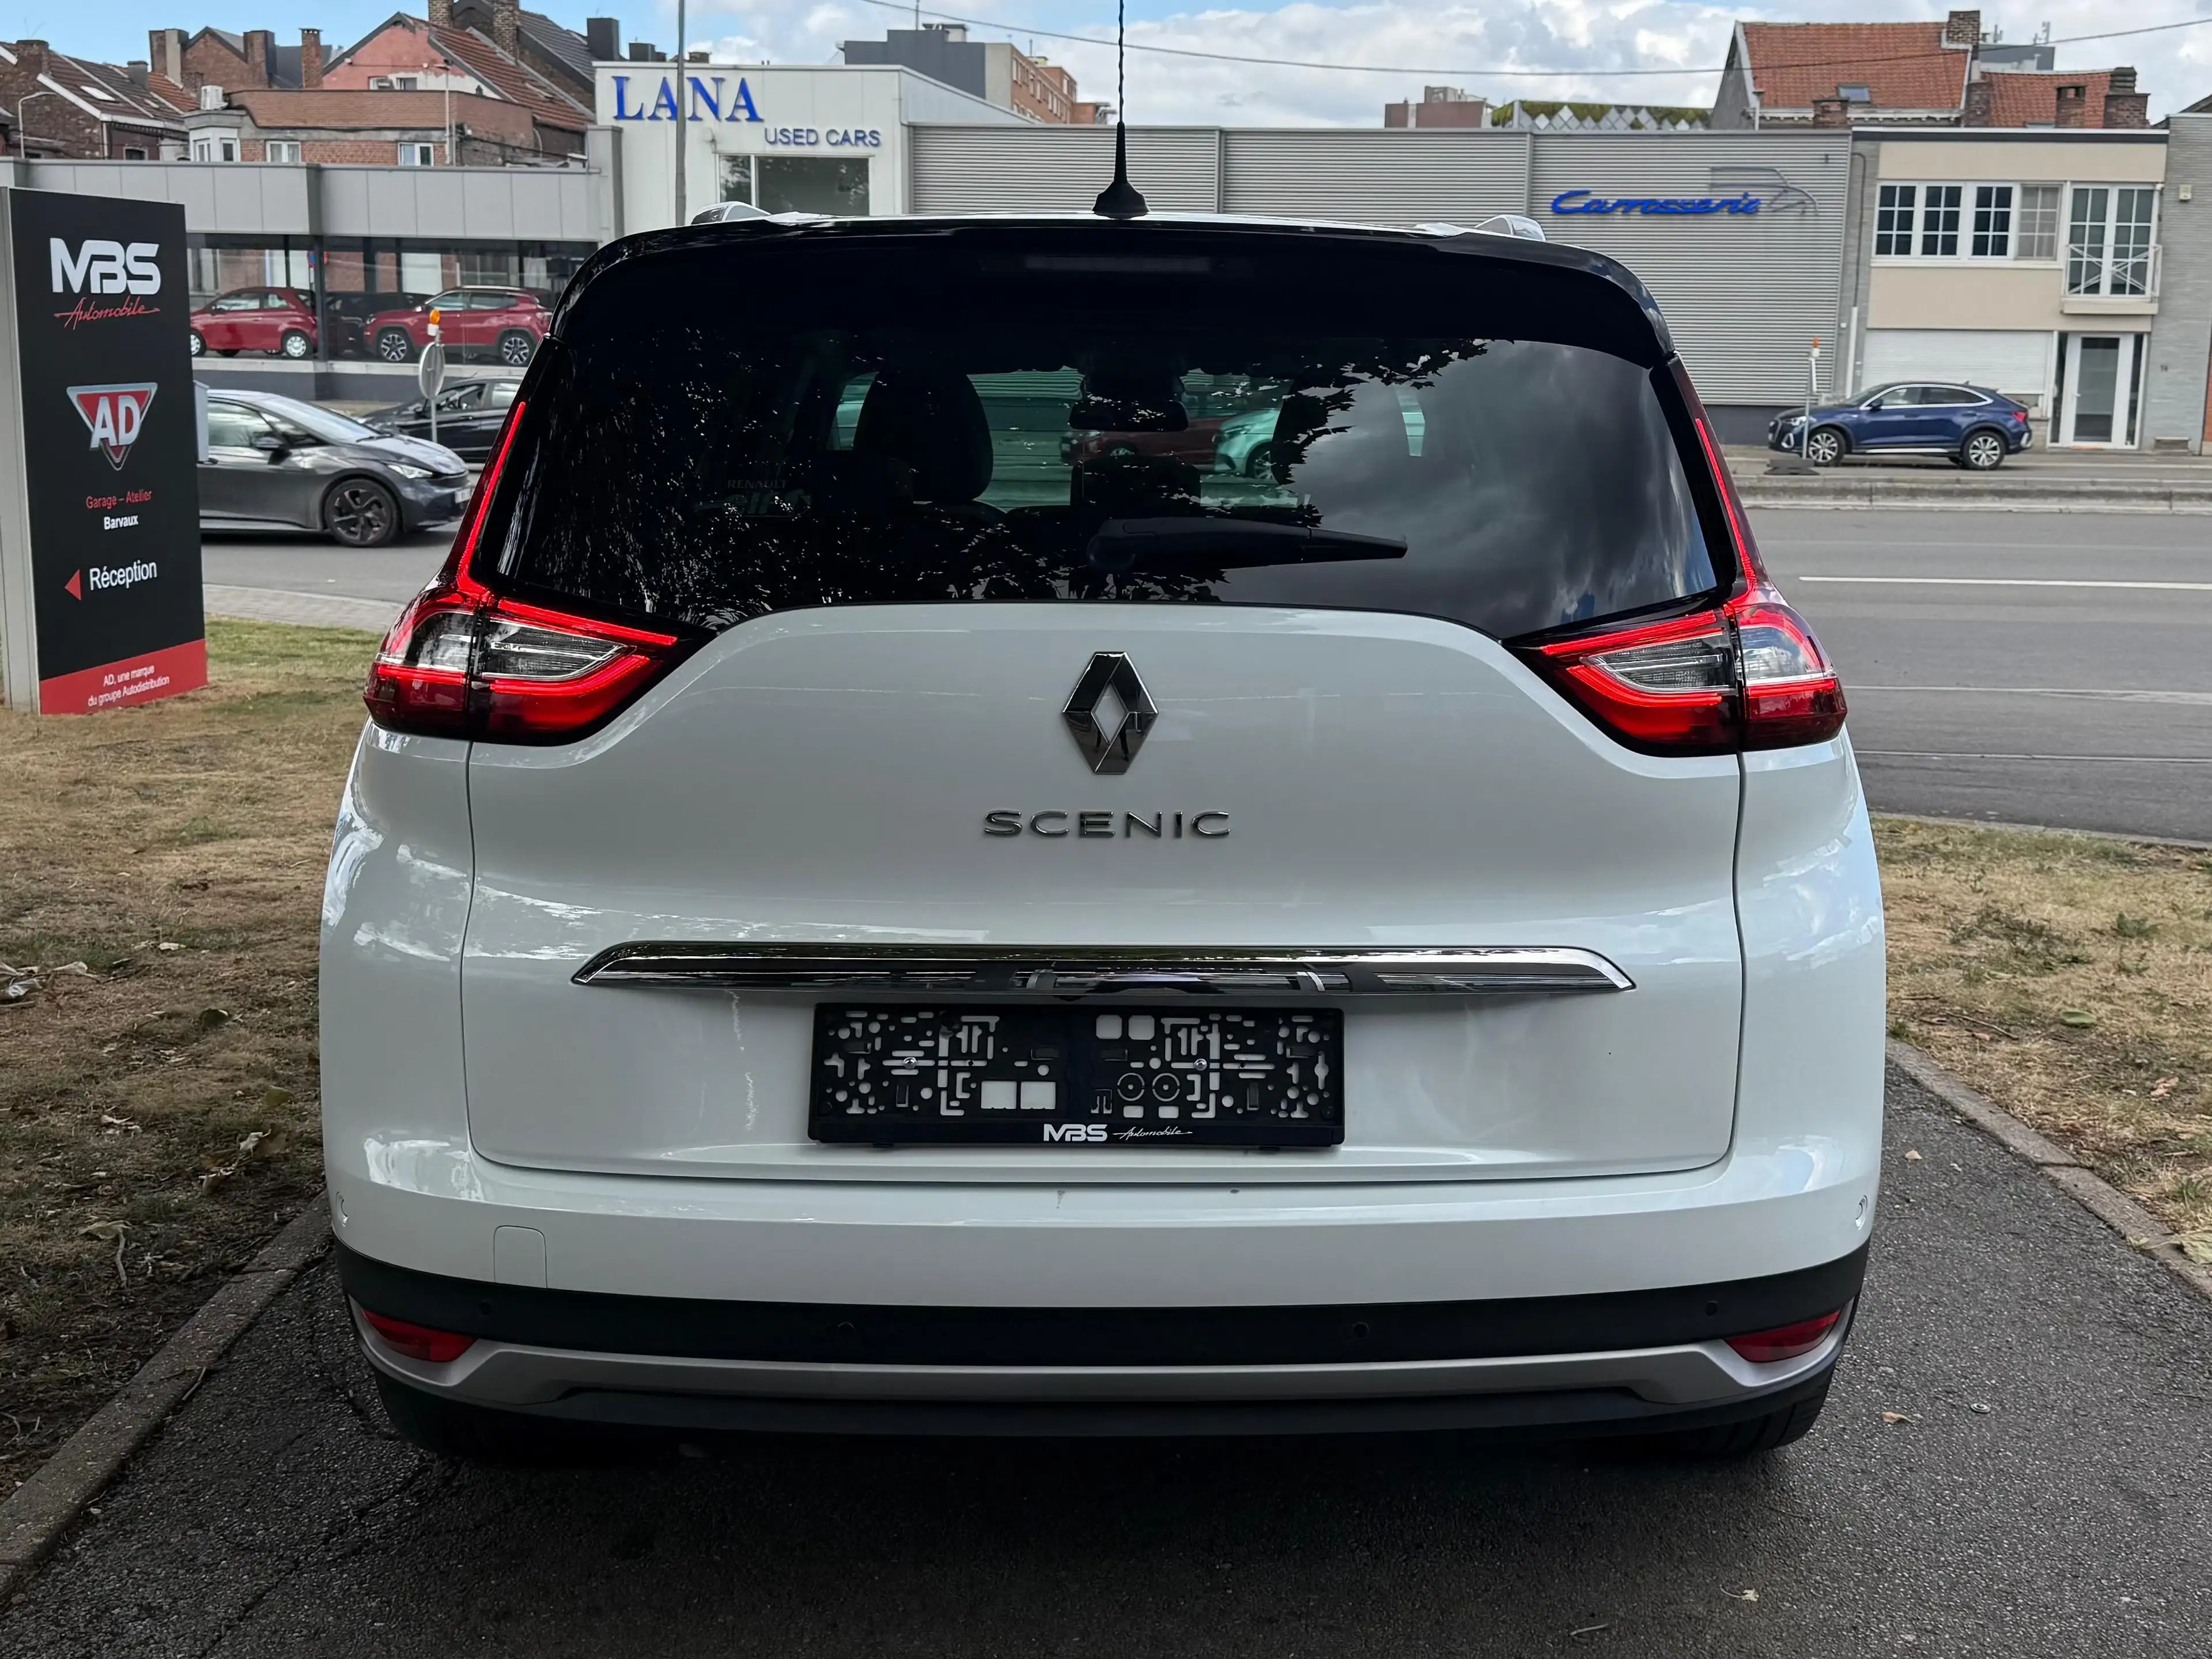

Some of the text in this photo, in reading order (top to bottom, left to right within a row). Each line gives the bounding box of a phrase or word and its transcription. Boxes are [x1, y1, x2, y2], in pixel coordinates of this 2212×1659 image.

[611, 75, 764, 122] LANA
[765, 127, 882, 147] USED CARS
[1551, 188, 1760, 214] Carrosserie
[50, 237, 161, 295] MBS
[54, 296, 160, 330] Automobile
[89, 395, 141, 450] AD
[86, 496, 117, 509] Garage
[126, 489, 152, 503] Atelier
[104, 515, 139, 530] Barvaux
[89, 559, 157, 591] Réception
[118, 672, 130, 683] une
[131, 665, 154, 678] marque
[88, 676, 169, 706] du groupe Autodistribution
[984, 810, 1231, 838] SCENIC
[1043, 1124, 1193, 1142] MBS Automobile
